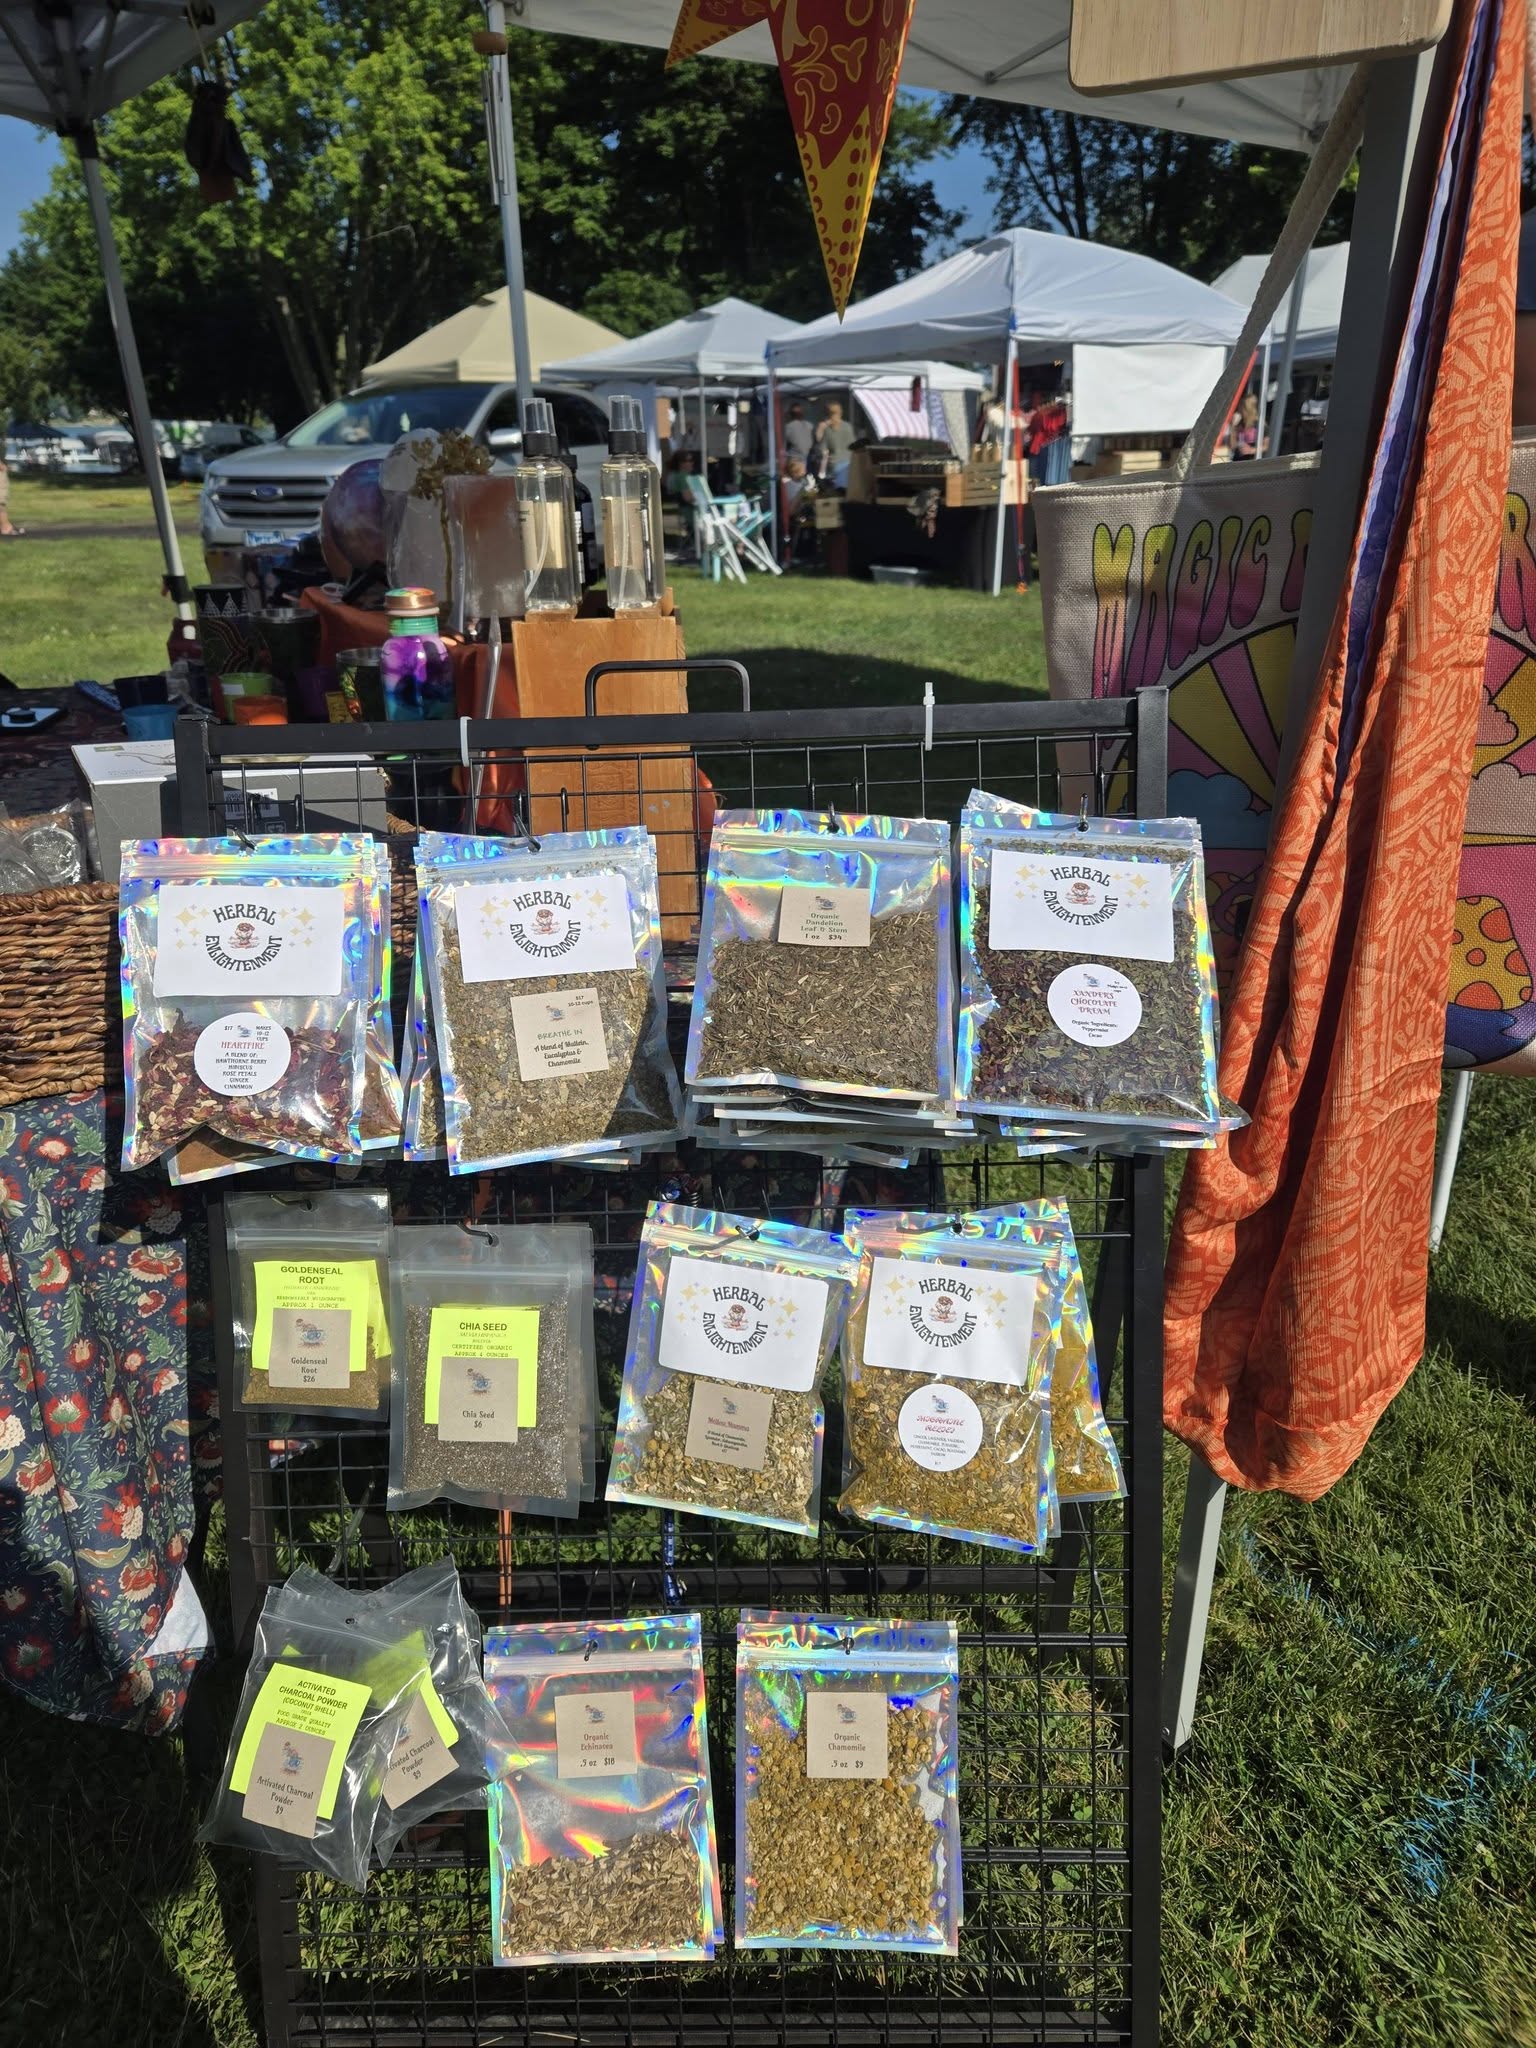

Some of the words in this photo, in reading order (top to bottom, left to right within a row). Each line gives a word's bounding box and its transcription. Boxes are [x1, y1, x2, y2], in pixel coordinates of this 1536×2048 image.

[1092, 515, 1271, 698] MAGIC
[1050, 866, 1111, 886] HERBAL
[513, 890, 572, 911] HERBAL
[1044, 890, 1118, 926] ENLIGHTENMENT
[213, 904, 276, 925] HERBAL
[510, 920, 581, 958] ENLIGHTENMENT
[206, 935, 282, 971] ENLIGHTENMENT
[1071, 998, 1117, 1007] CHOCOLATE
[1073, 990, 1114, 999] XANDERS
[1078, 1007, 1111, 1015] DREAM
[538, 1030, 572, 1040] BREATHE
[558, 1041, 564, 1050] of
[544, 1050, 576, 1059] Eucalyptus
[548, 1058, 581, 1067] Chamomile
[281, 1266, 343, 1275] GOLDENSEAL
[919, 1278, 973, 1302] HERBAL
[713, 1286, 766, 1311] HERBAL
[459, 1322, 481, 1330] CHIA
[483, 1323, 507, 1331] SEED
[703, 1312, 768, 1354] ENLIGHTENMENT
[910, 1305, 977, 1348] ENLIGHTENMENT
[297, 1680, 337, 1695] ACTIVATED
[278, 1686, 315, 1702] CHARCOAL
[317, 1696, 348, 1710] POWDER
[282, 1698, 314, 1711] (COCONUT
[314, 1705, 336, 1717] SHELL)
[277, 1709, 290, 1718] FOOD
[309, 1717, 332, 1728] QUALITY
[583, 1733, 609, 1742] Organic
[834, 1733, 860, 1742] Organic
[410, 1736, 435, 1757] Charcoal
[828, 1743, 866, 1751] Chamomile
[402, 1758, 423, 1775] Powder
[580, 1759, 586, 1767] .5
[413, 1770, 422, 1780] $9
[256, 1776, 286, 1792] Activated
[286, 1784, 314, 1799] Charcoal
[270, 1792, 294, 1807] Powder
[275, 1805, 284, 1815] $9
